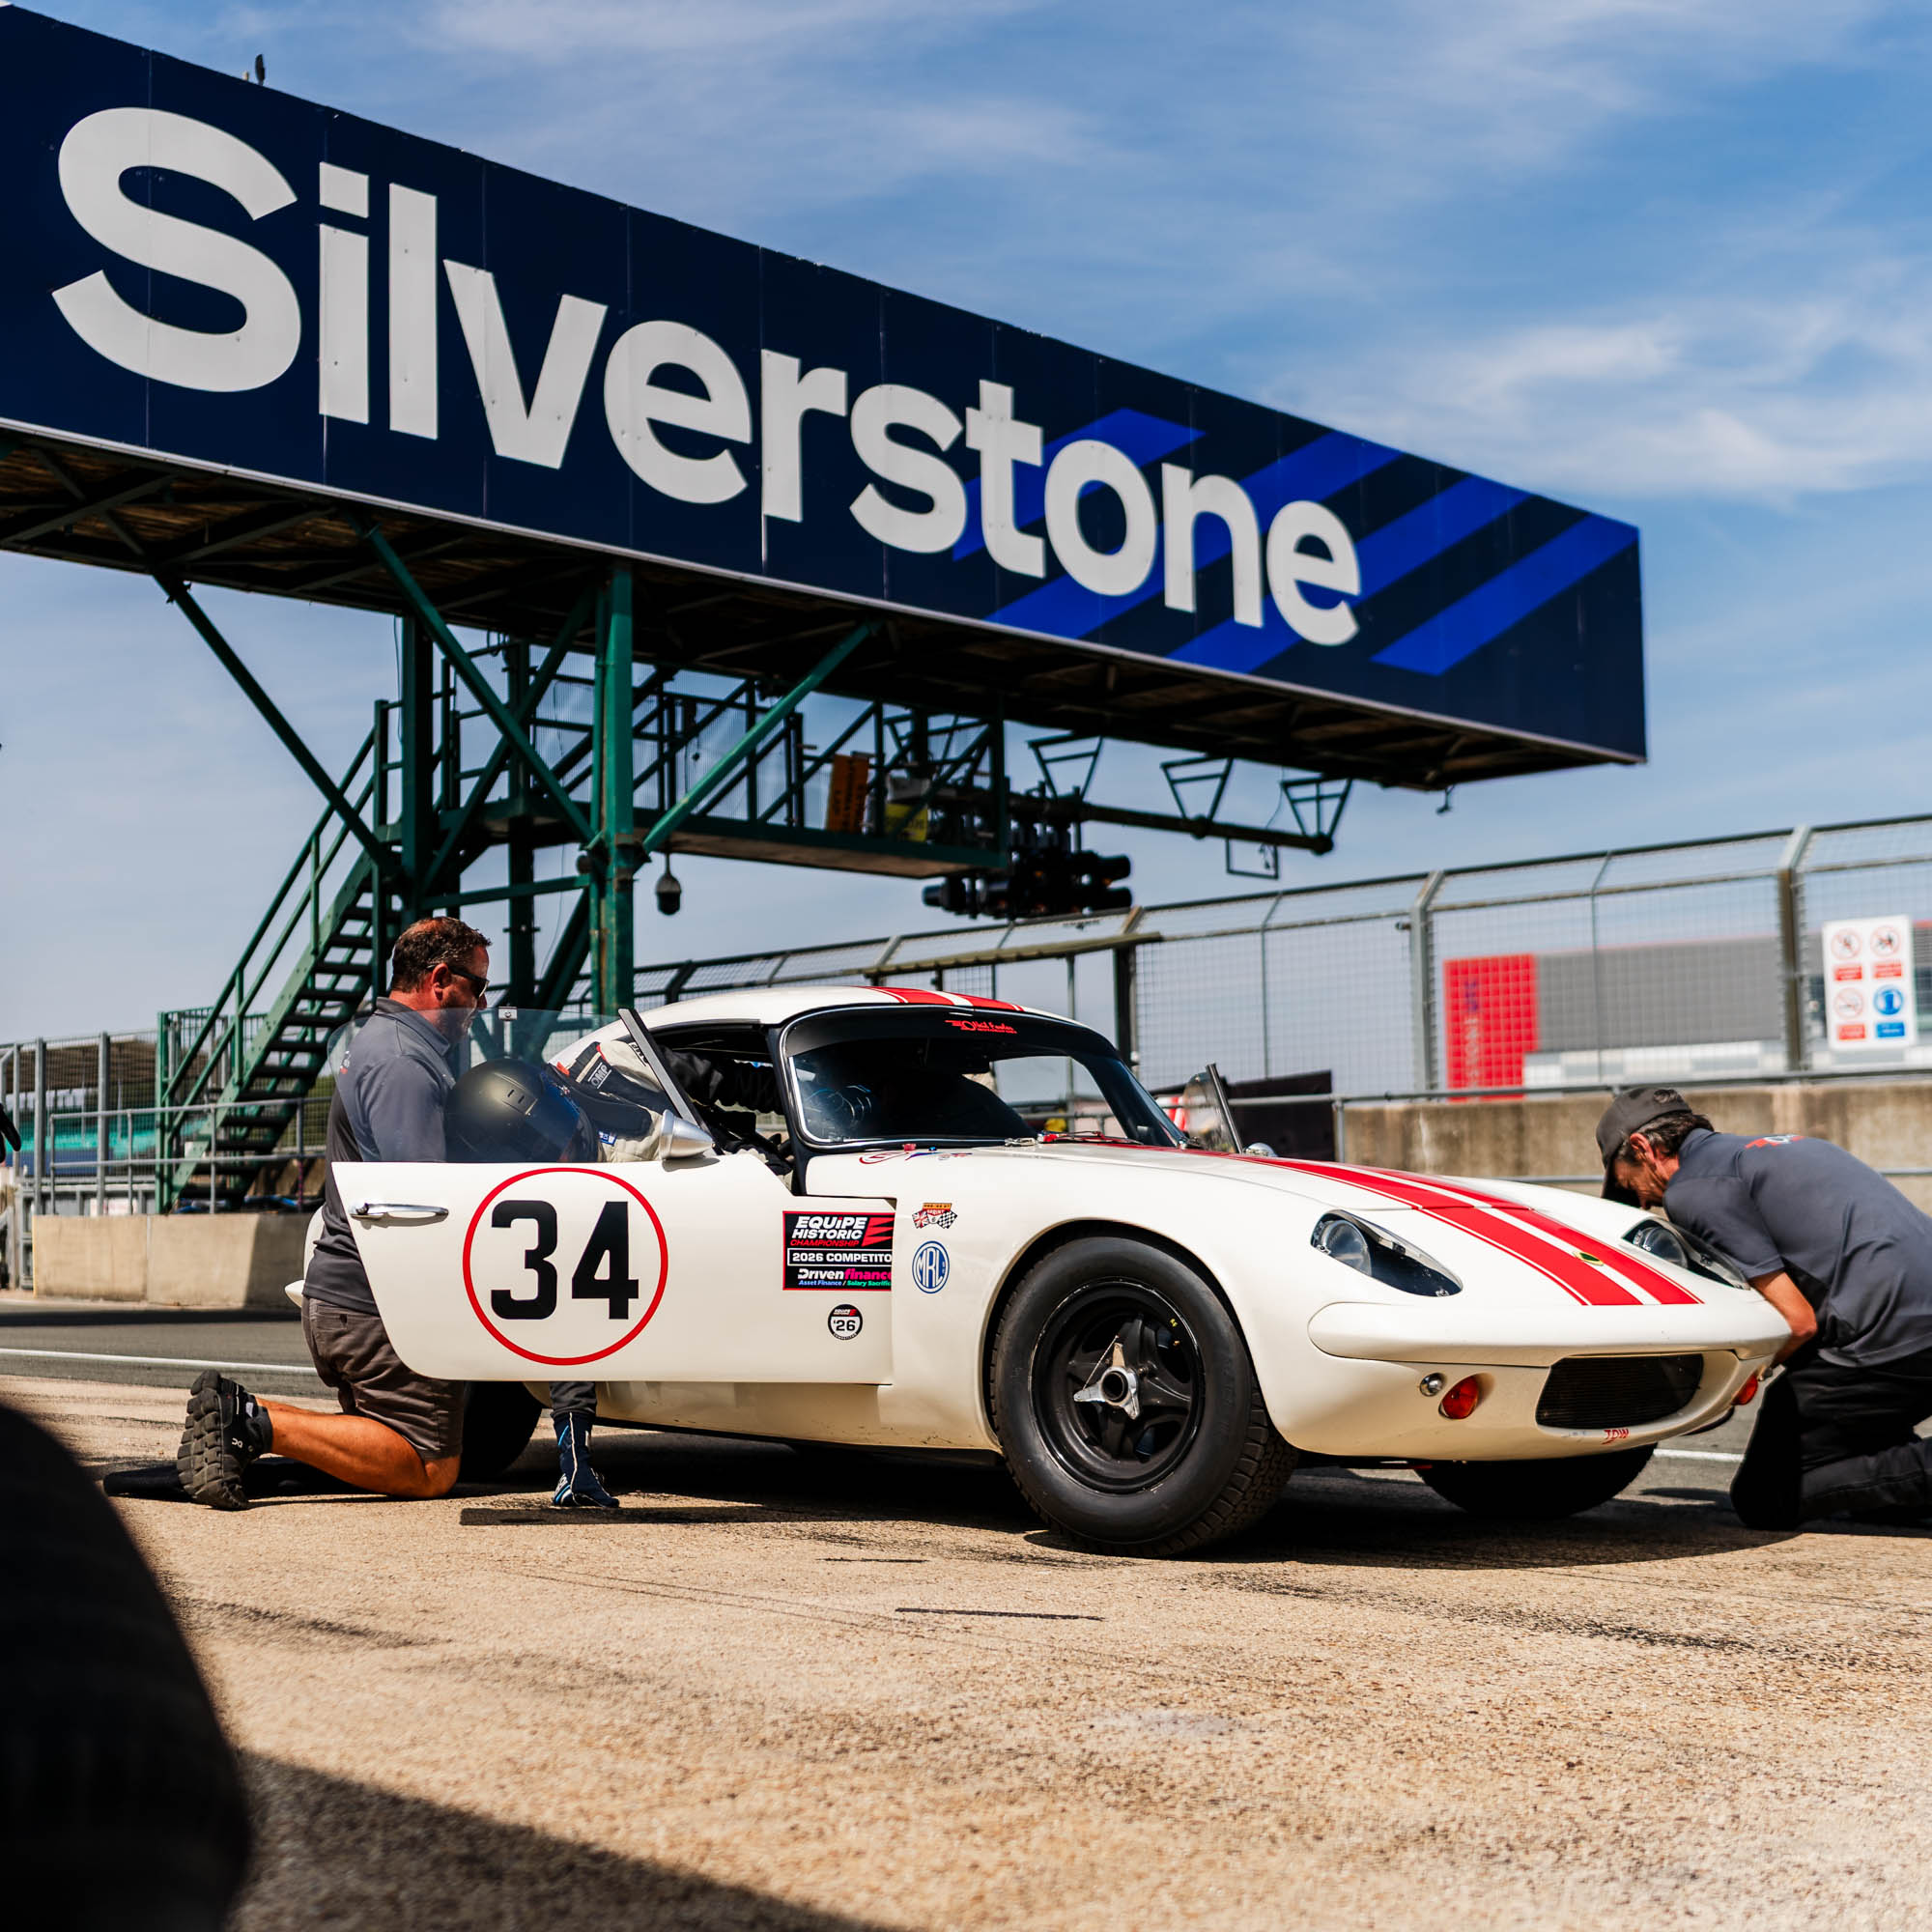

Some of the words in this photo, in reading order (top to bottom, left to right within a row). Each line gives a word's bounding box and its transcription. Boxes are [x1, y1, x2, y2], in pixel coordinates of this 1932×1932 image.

[51, 107, 1360, 645] Silverstone
[591, 1065, 609, 1087] OMP
[791, 1229, 864, 1239] HISTORIC
[789, 1238, 860, 1247] CHAMPIONSHIP
[491, 1199, 639, 1321] 34
[792, 1252, 824, 1263] 2026
